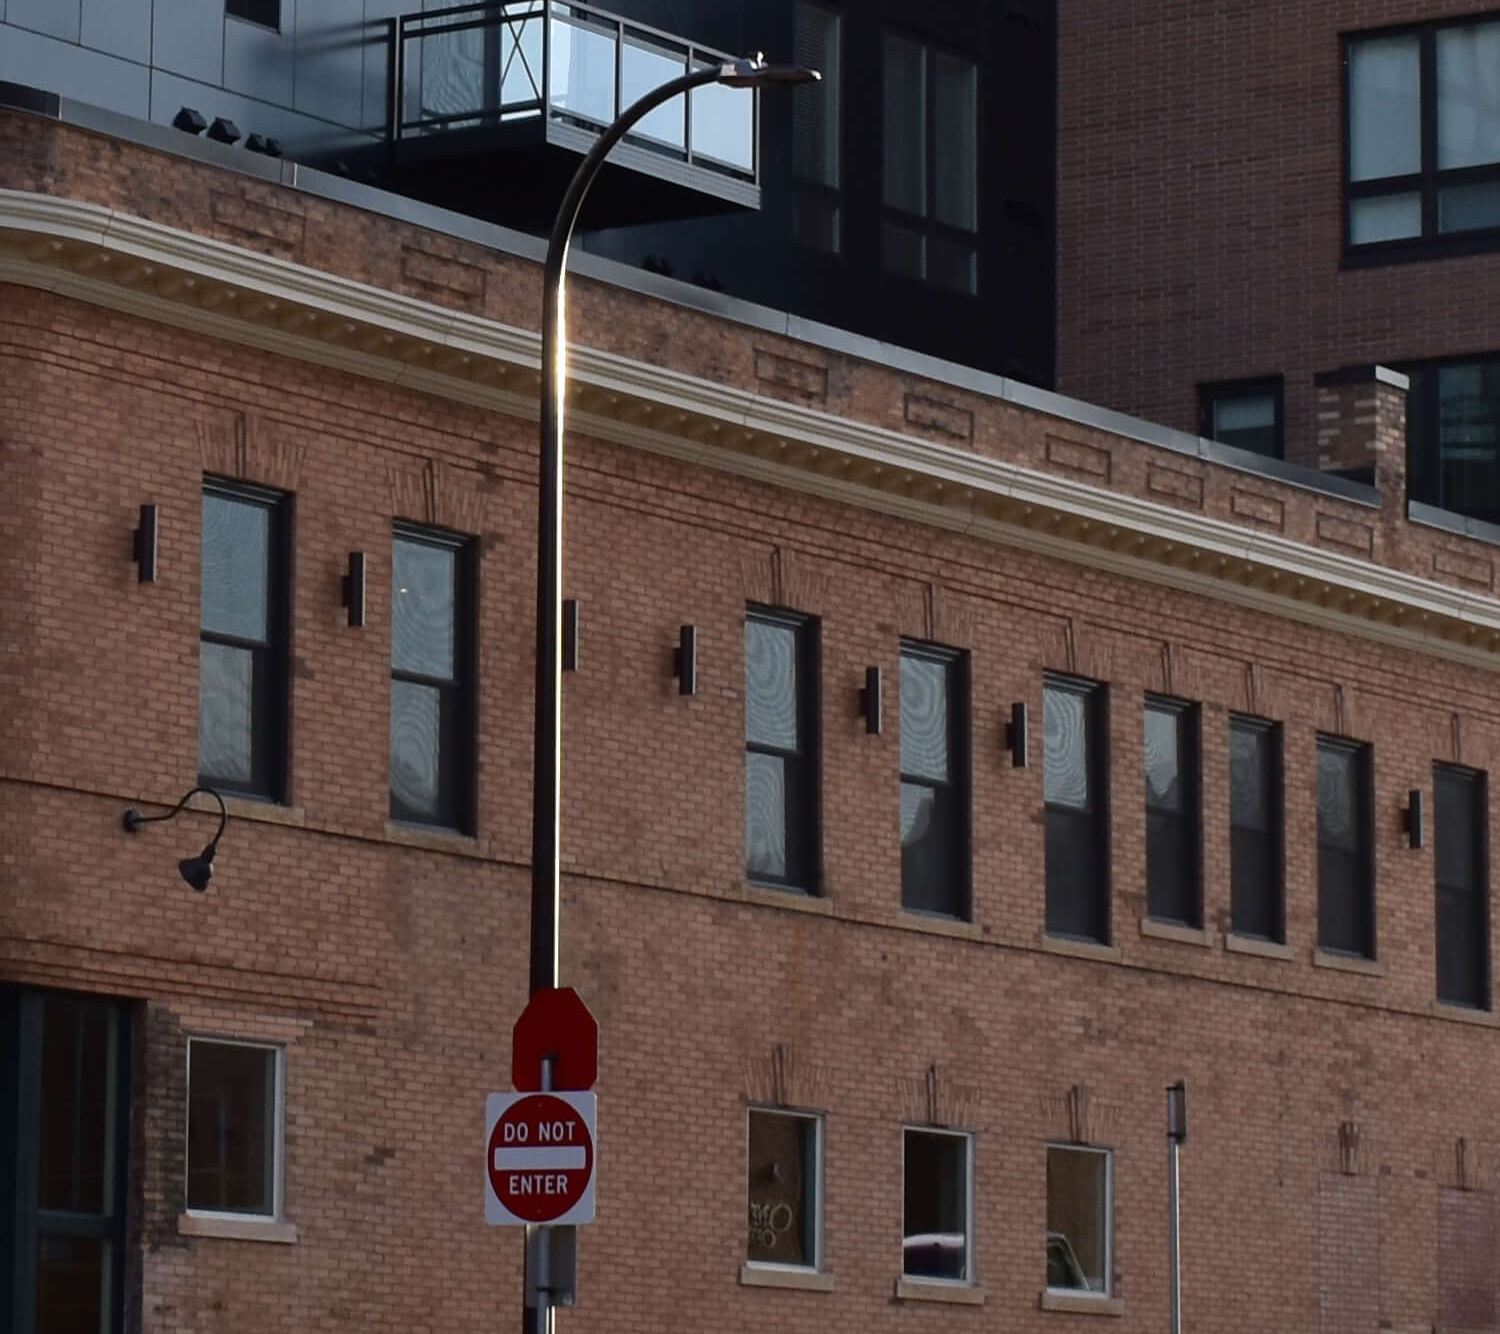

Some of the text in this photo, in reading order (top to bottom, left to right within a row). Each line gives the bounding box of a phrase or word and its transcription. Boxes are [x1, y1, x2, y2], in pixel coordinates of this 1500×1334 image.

[503, 1121, 577, 1143] DO NOT
[509, 1175, 569, 1196] ENTER
